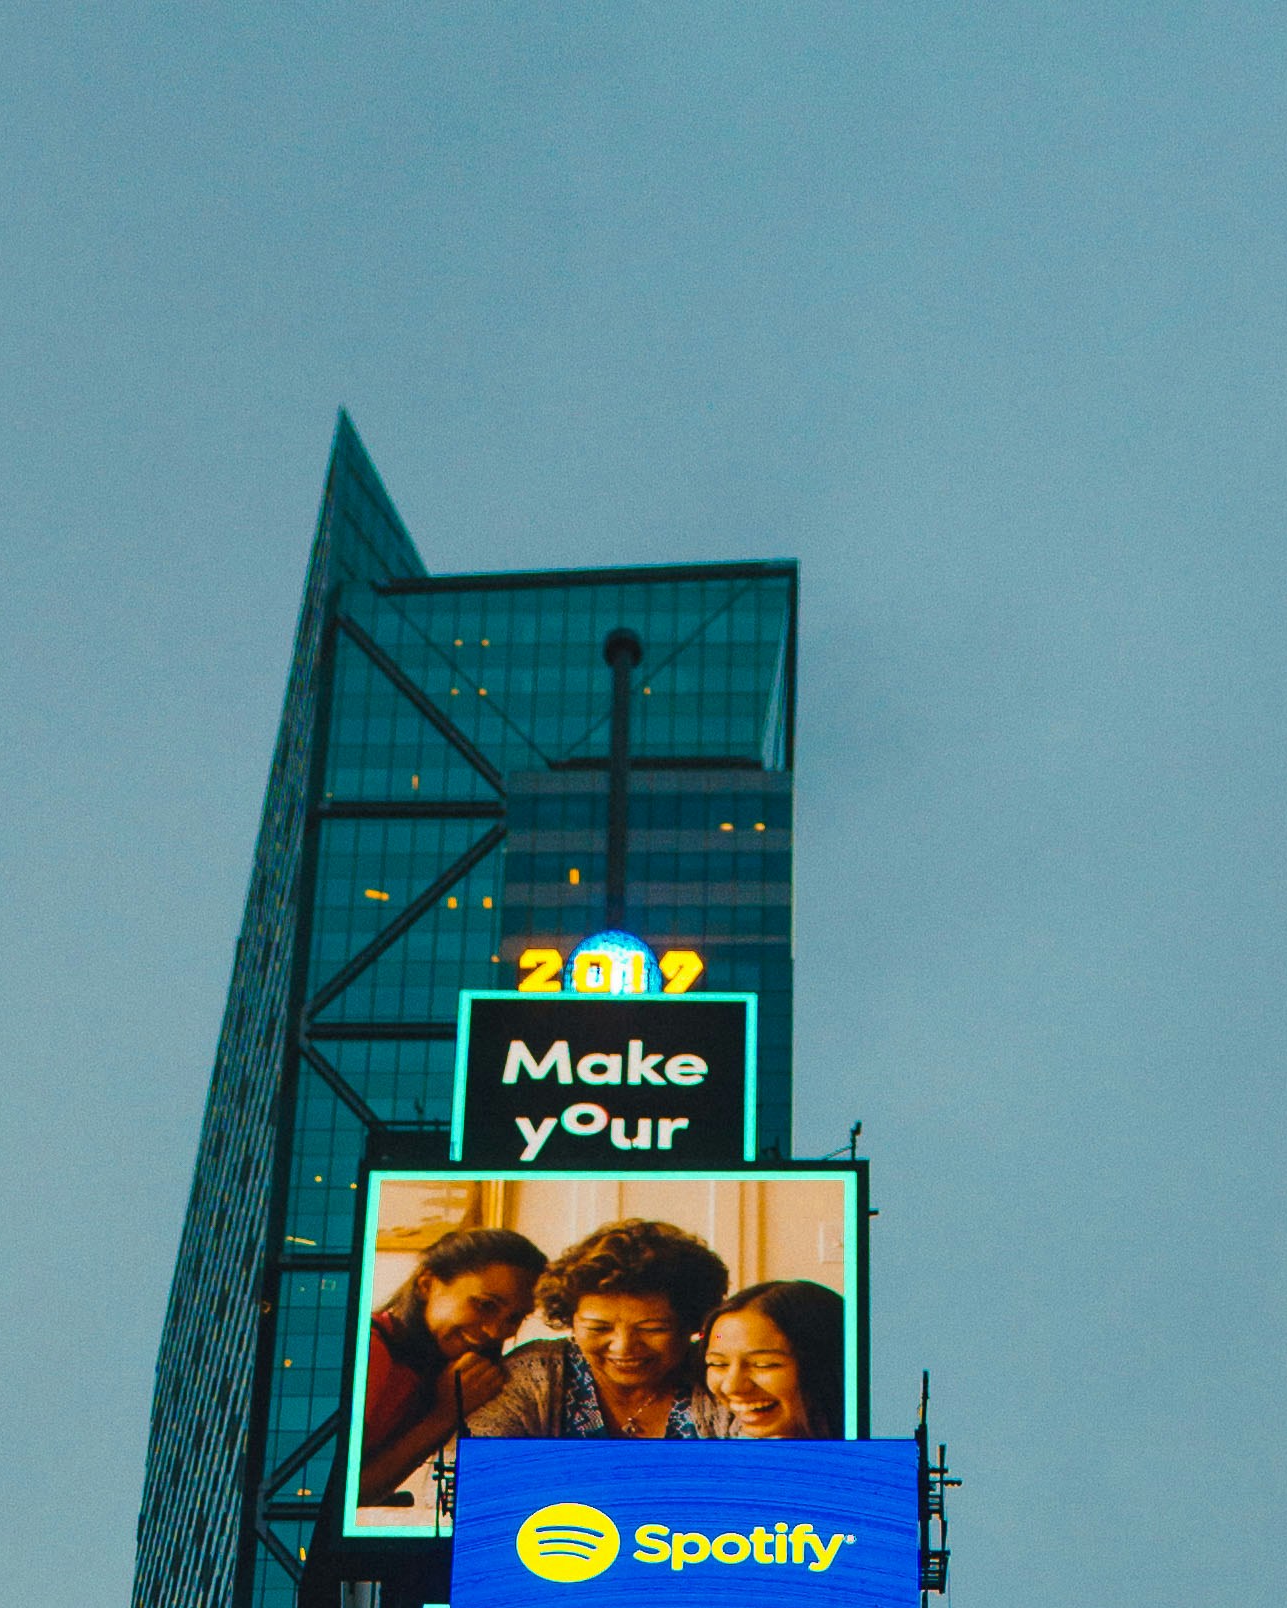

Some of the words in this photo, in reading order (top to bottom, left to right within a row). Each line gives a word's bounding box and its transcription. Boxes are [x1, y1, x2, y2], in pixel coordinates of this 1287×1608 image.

[519, 948, 704, 994] 2019
[502, 1039, 709, 1087] Make
[515, 1102, 690, 1162] your
[633, 1522, 850, 1572] Spotify
